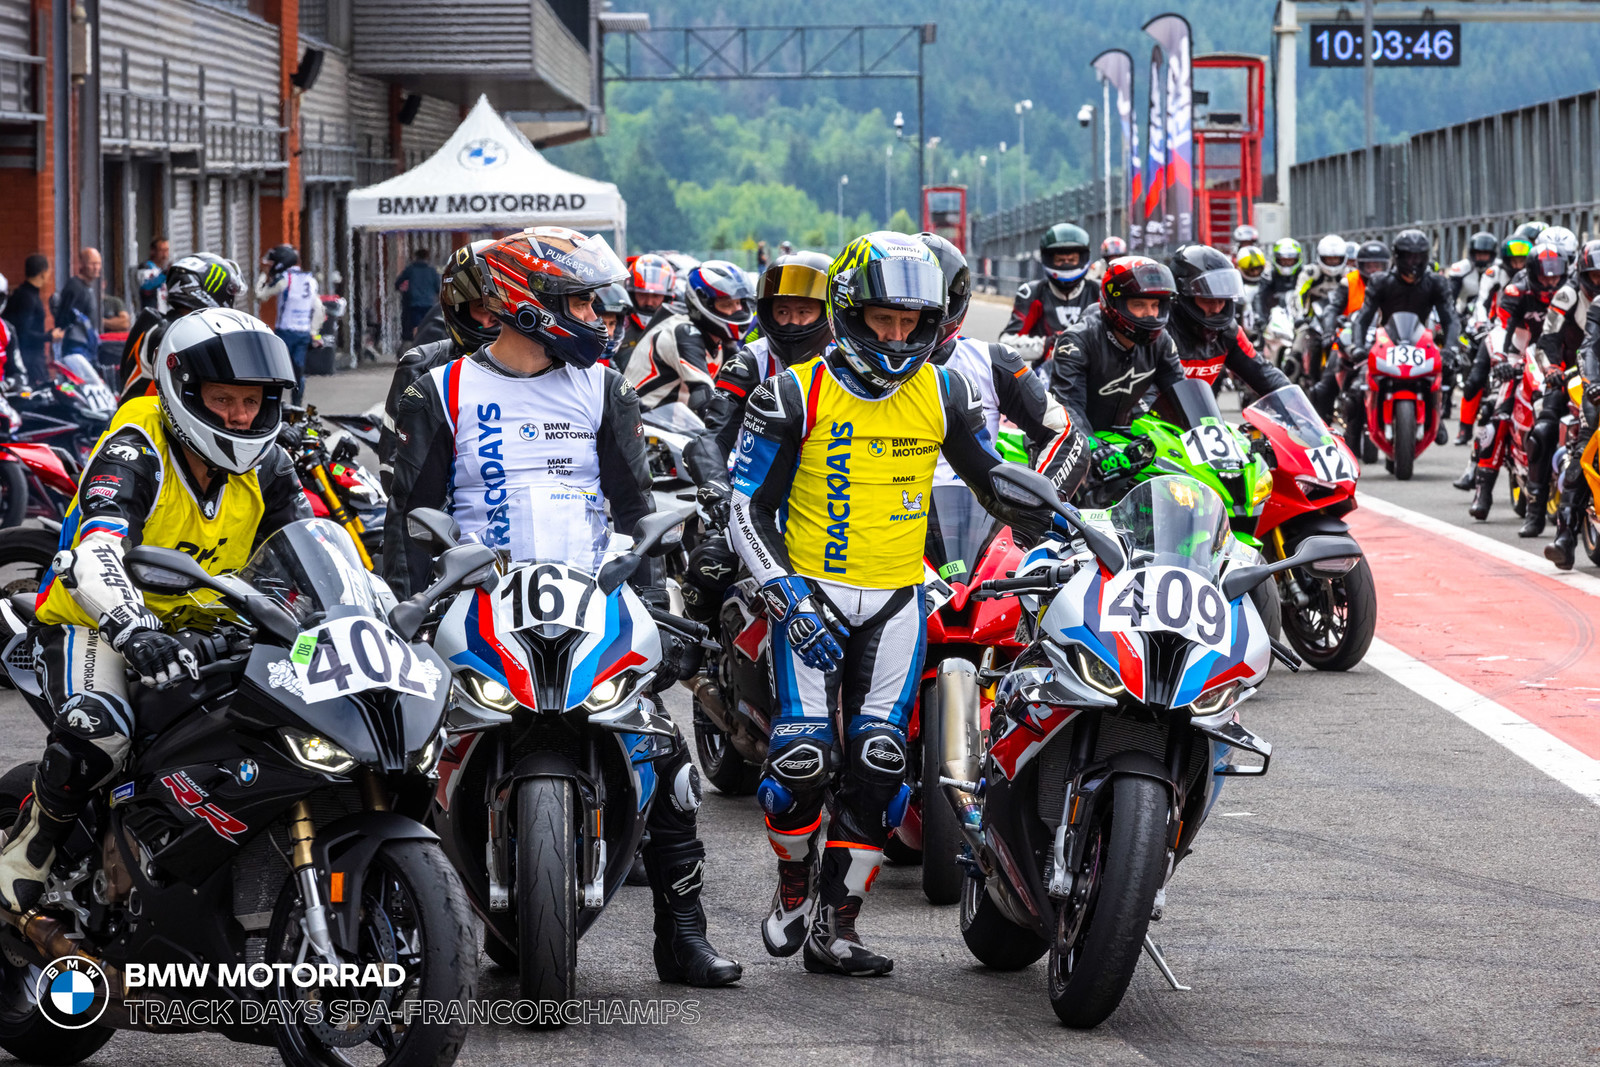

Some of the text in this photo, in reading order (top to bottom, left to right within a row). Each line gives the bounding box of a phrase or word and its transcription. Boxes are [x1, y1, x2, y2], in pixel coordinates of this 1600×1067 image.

[1316, 30, 1454, 61] 10:03:46
[378, 193, 586, 214] BMW MOTORRAD
[546, 248, 595, 278] PULL&BEAR
[1387, 345, 1424, 366] 136
[543, 422, 570, 431] BMW
[545, 431, 597, 440] MOTORRA
[892, 438, 918, 447] BMW
[892, 443, 940, 457] MOTORRA
[1186, 425, 1242, 462] 13
[477, 402, 511, 548] RACKDAYS
[547, 457, 573, 466] MAKE
[1051, 432, 1084, 491] DAINESE
[1311, 445, 1355, 482] 12
[892, 475, 916, 483] MAKE
[823, 421, 854, 575] TRACKDAYS
[733, 503, 746, 525] BMW
[741, 525, 772, 570] MOTORRAD
[946, 563, 960, 574] DB
[501, 564, 598, 629] 167
[1108, 569, 1226, 646] 409
[83, 628, 99, 692] BMW MOTORRAD
[296, 643, 312, 657] DB
[307, 619, 428, 694] 402
[770, 723, 829, 740] RST
[779, 757, 820, 770] RST
[868, 749, 903, 763] RST
[178, 770, 210, 798] S1000
[160, 772, 249, 846] RR
